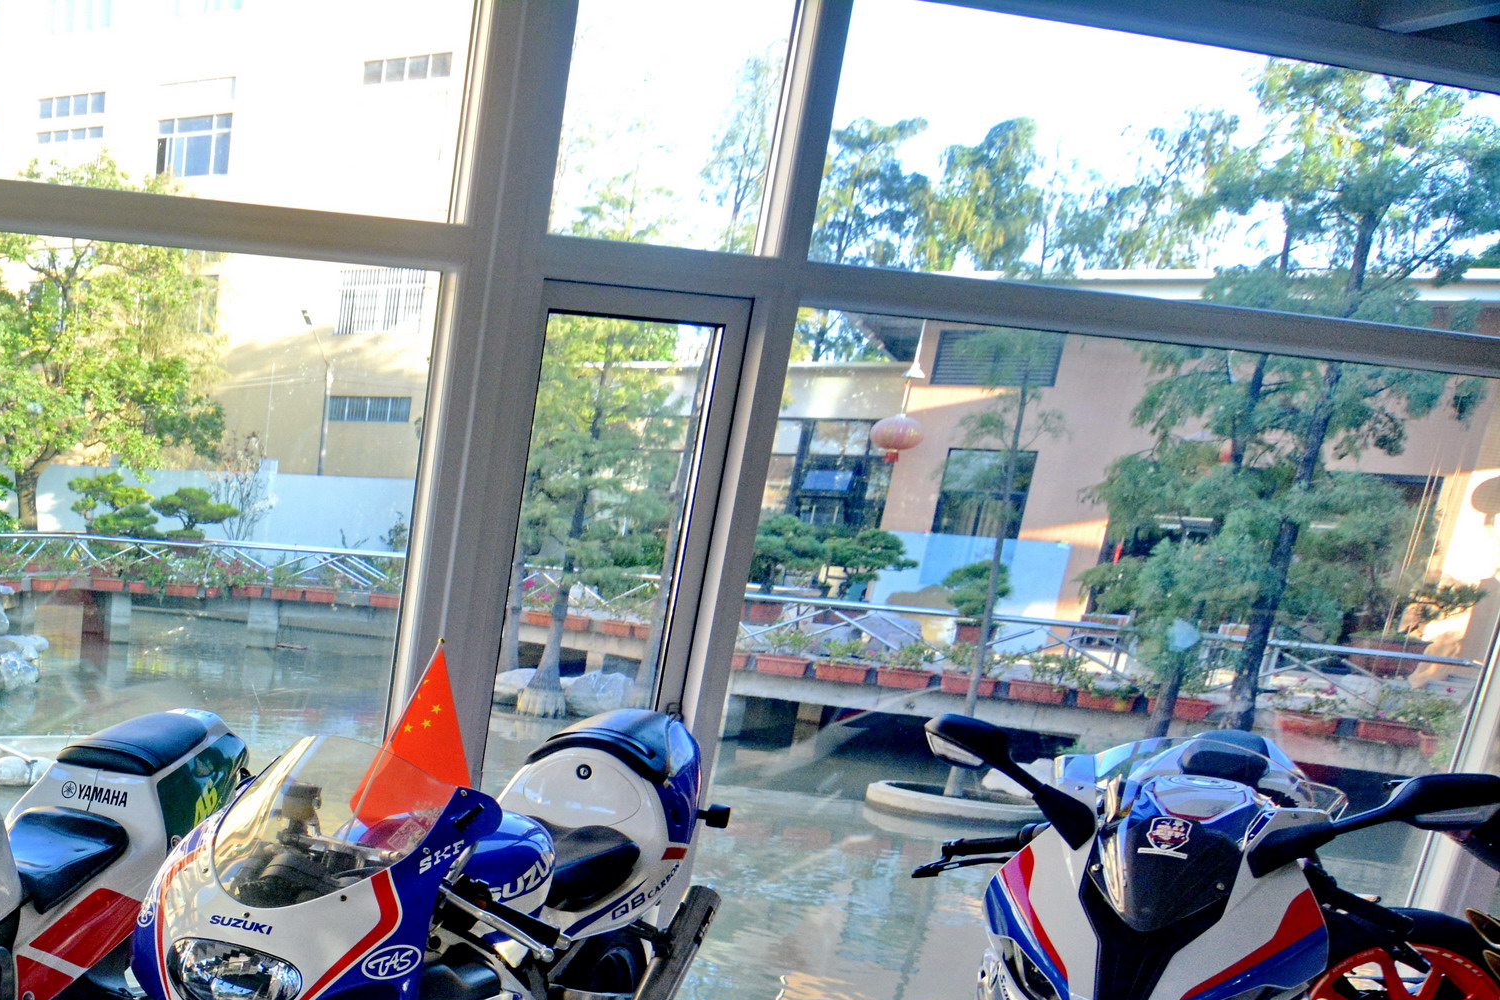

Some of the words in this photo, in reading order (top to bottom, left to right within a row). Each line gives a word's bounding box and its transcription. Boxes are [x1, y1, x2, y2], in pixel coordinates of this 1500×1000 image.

[77, 783, 128, 807] YAMAHA
[419, 839, 465, 875] SKF
[612, 892, 646, 921] QB
[209, 915, 273, 936] SUZUKI
[367, 949, 414, 977] TAS
